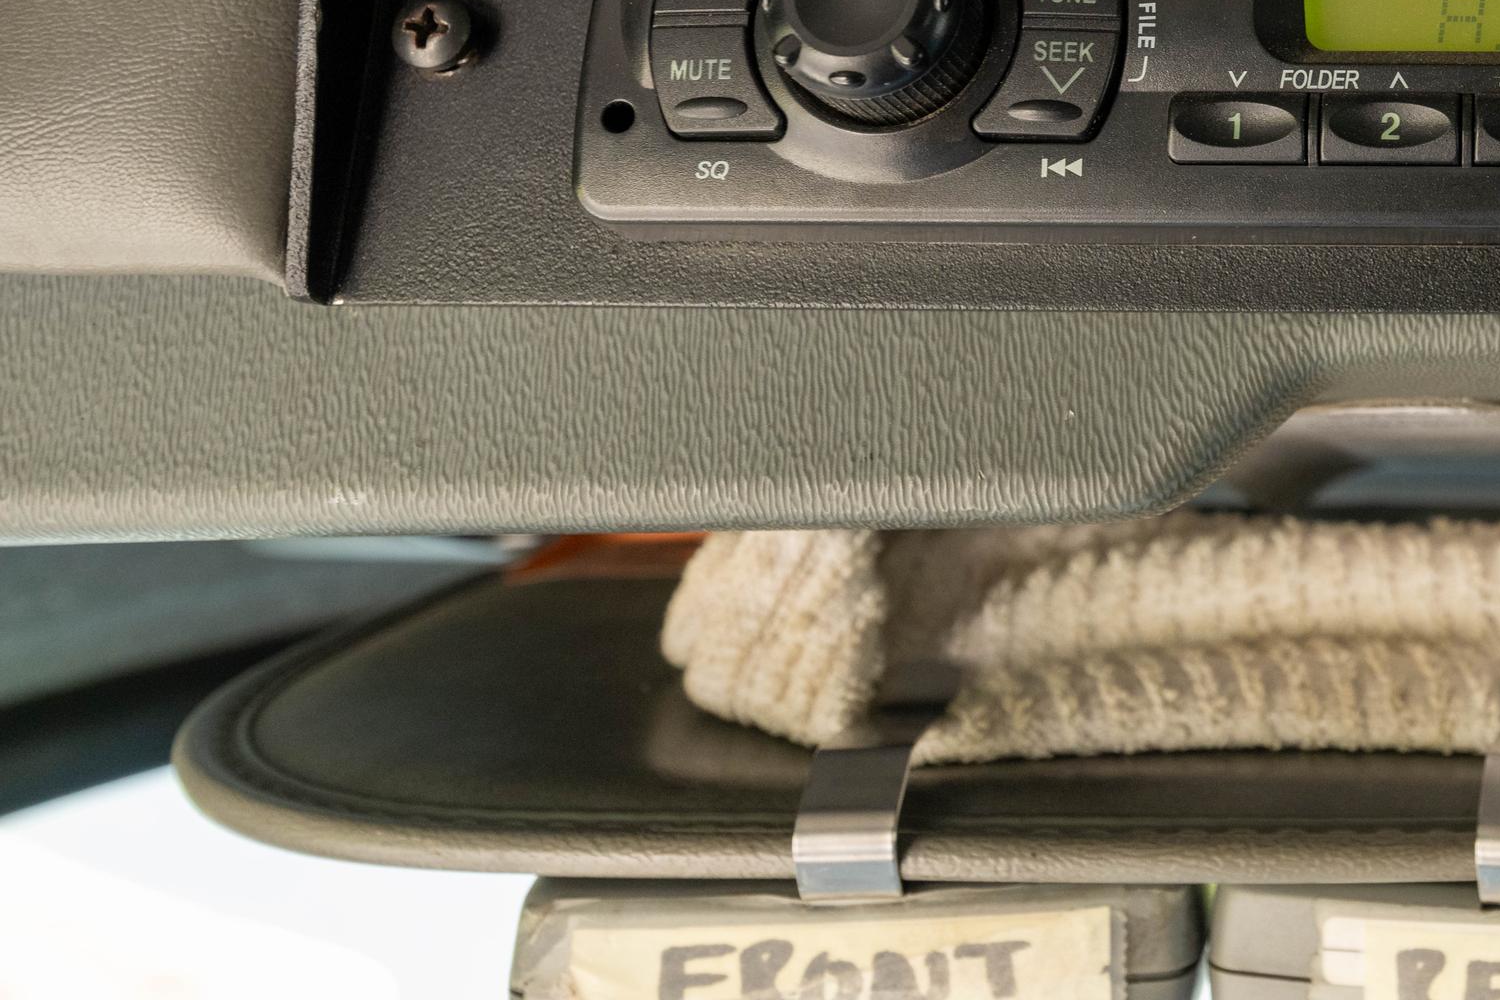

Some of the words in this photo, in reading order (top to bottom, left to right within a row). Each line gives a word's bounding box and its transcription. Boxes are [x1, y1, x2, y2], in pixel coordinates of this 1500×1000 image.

[1137, 1, 1157, 50] FILE
[1034, 42, 1095, 63] SEEK
[670, 59, 732, 81] MUTE
[1280, 70, 1359, 90] FOLDER
[1228, 113, 1242, 140] 1
[1380, 113, 1401, 140] 2
[695, 161, 730, 181] SQ
